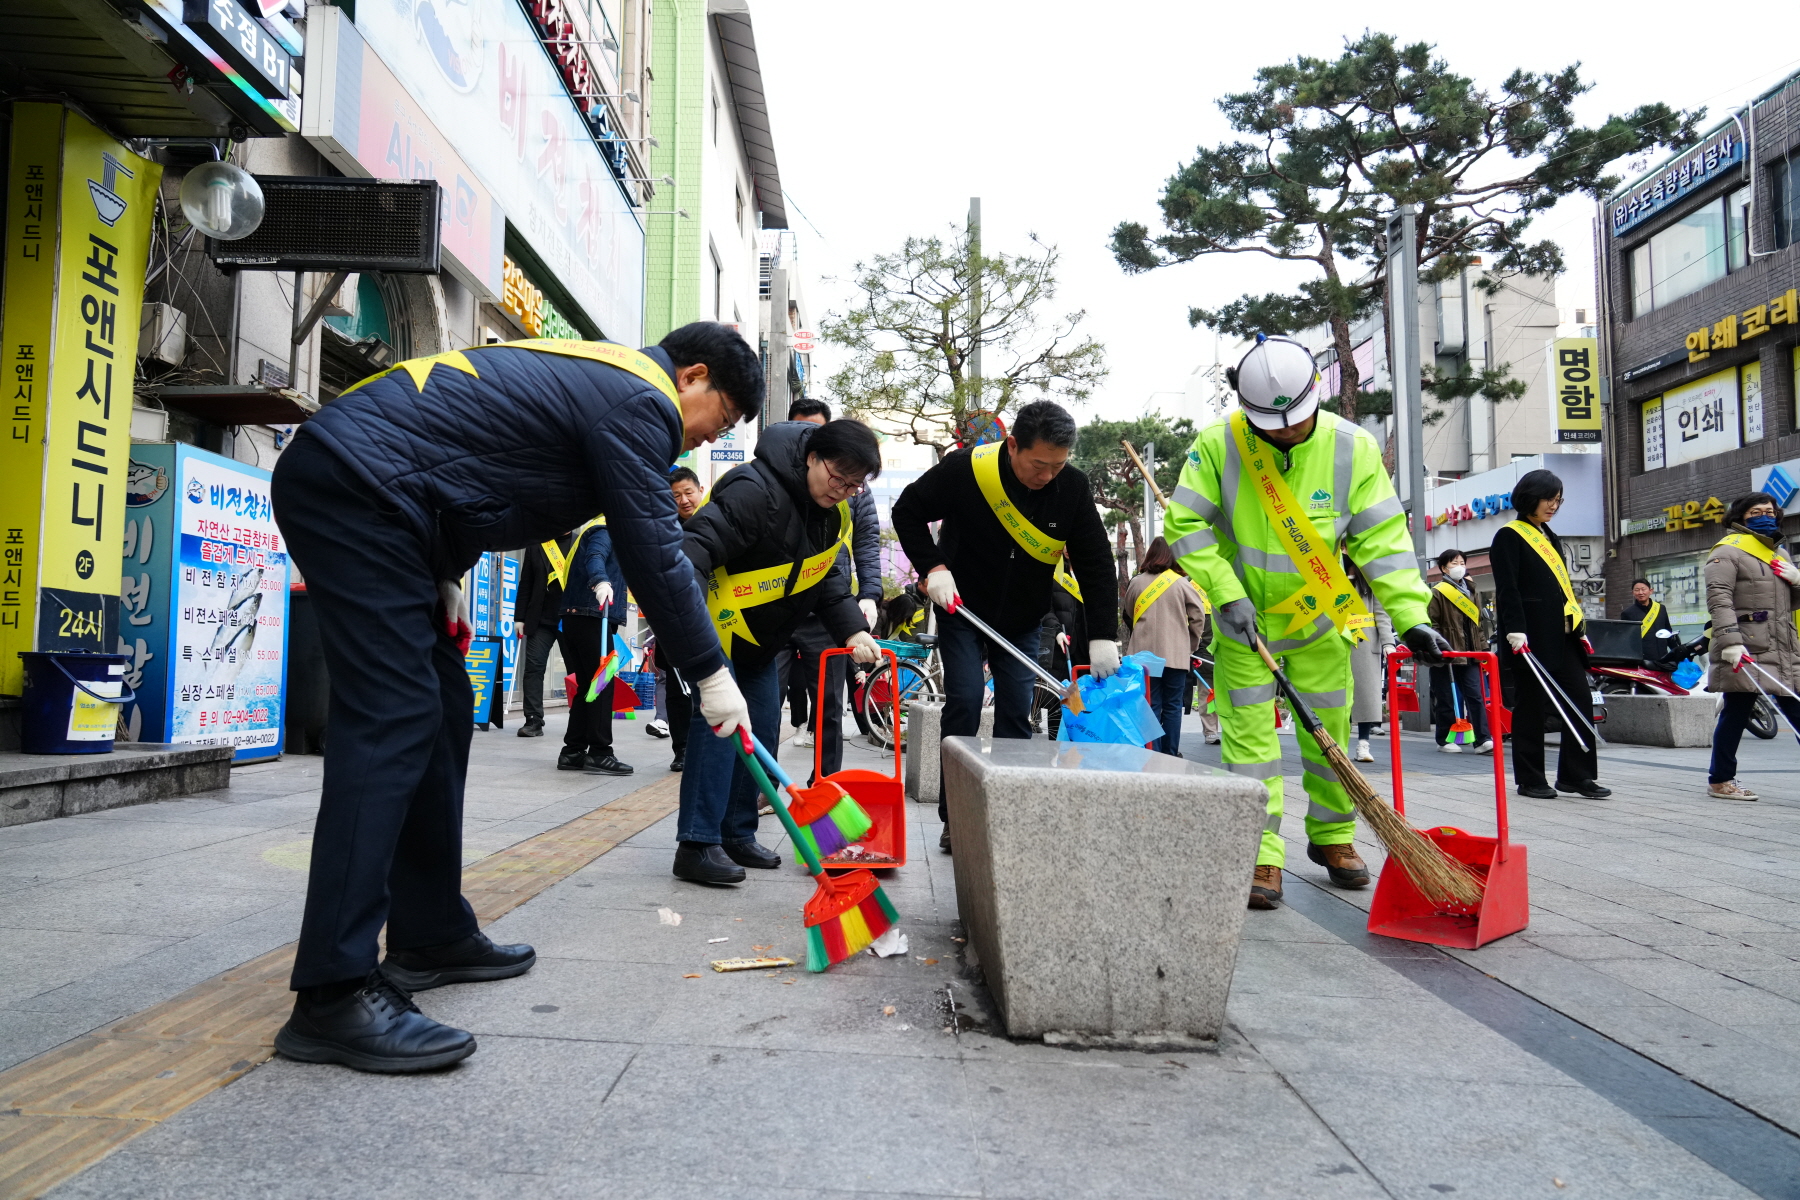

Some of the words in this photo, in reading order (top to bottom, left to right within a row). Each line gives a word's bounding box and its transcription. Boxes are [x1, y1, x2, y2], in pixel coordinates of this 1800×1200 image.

[263, 38, 285, 88] B1
[22, 164, 45, 262] 포앤시드니
[1686, 289, 1800, 363] 인쇄코리
[12, 344, 36, 443] 포앤시드니
[72, 232, 120, 542] 포앤시드니
[1559, 348, 1594, 419] 명함
[893, 428, 949, 442] 강북구
[1678, 398, 1724, 443] 인쇄
[712, 451, 743, 461] 906-3456
[210, 484, 271, 522] 비젼참치
[1663, 497, 1725, 532] 김은숙
[197, 519, 229, 541] 자연산
[232, 527, 279, 551] 고급참치를
[1253, 459, 1264, 471] 앞
[1261, 474, 1287, 514] 쓰레기는
[1281, 516, 1312, 556] 내손으로
[1307, 556, 1333, 590] 치워요!
[77, 555, 93, 574] 2F
[201, 542, 234, 564] 즐겁게
[1, 528, 25, 630] 포앤시드니
[184, 607, 238, 627] 비젼스페셜
[1294, 600, 1310, 615] 강북구
[1337, 599, 1355, 614] 강북구
[58, 608, 103, 642] 24시
[720, 618, 738, 630] 강북구
[182, 646, 193, 662] 특
[201, 647, 237, 663] 스페셜
[257, 650, 279, 661] 55,000
[180, 684, 203, 702] 실장
[205, 684, 235, 701] 스페셜
[255, 685, 278, 696] 65,000
[223, 708, 269, 724] 02-904-0022
[233, 733, 275, 747] 02-904-0022
